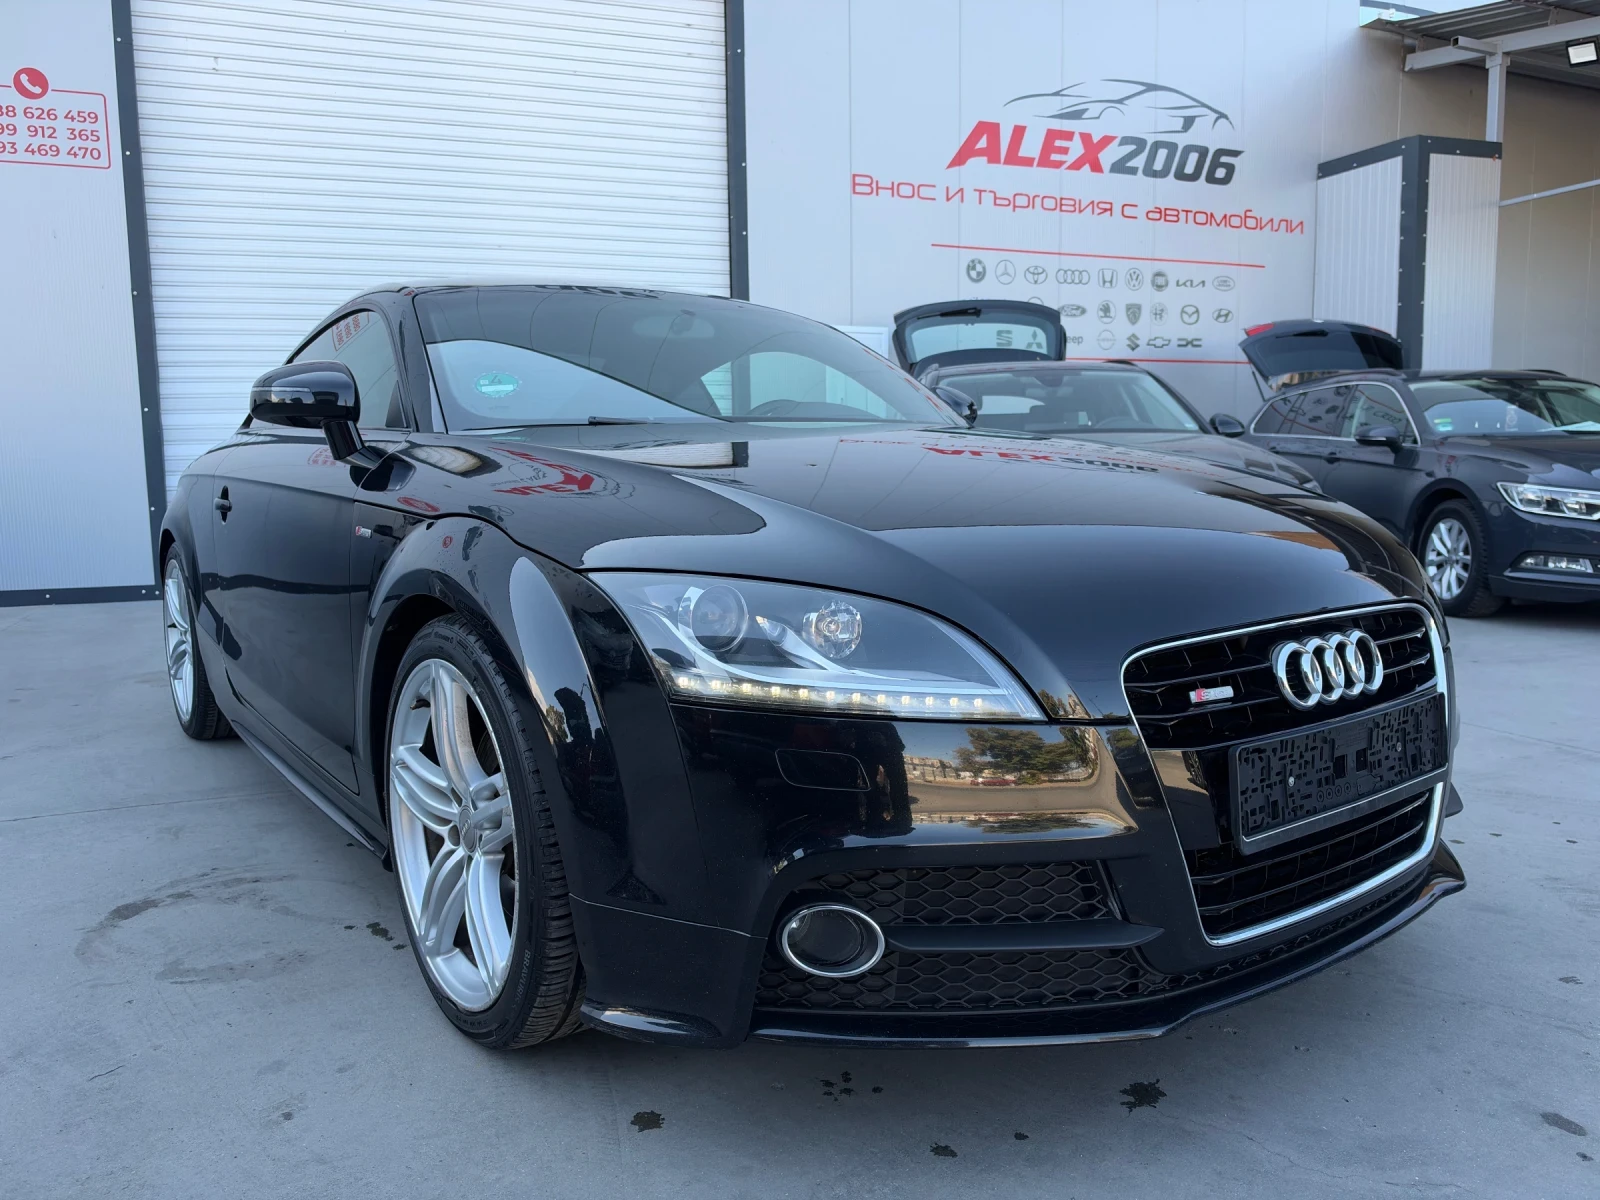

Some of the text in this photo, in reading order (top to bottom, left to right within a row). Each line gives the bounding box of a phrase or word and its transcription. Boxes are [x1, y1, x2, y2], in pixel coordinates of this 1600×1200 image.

[23, 106, 58, 121] 626
[63, 110, 99, 124] 459
[27, 125, 57, 139] 912
[66, 127, 101, 142] 365
[24, 143, 60, 157] 469
[66, 146, 102, 161] 470
[945, 120, 1245, 186] ALEX2006
[852, 173, 1304, 235] Внос и търговия с автомобили
[1066, 336, 1084, 346] eep
